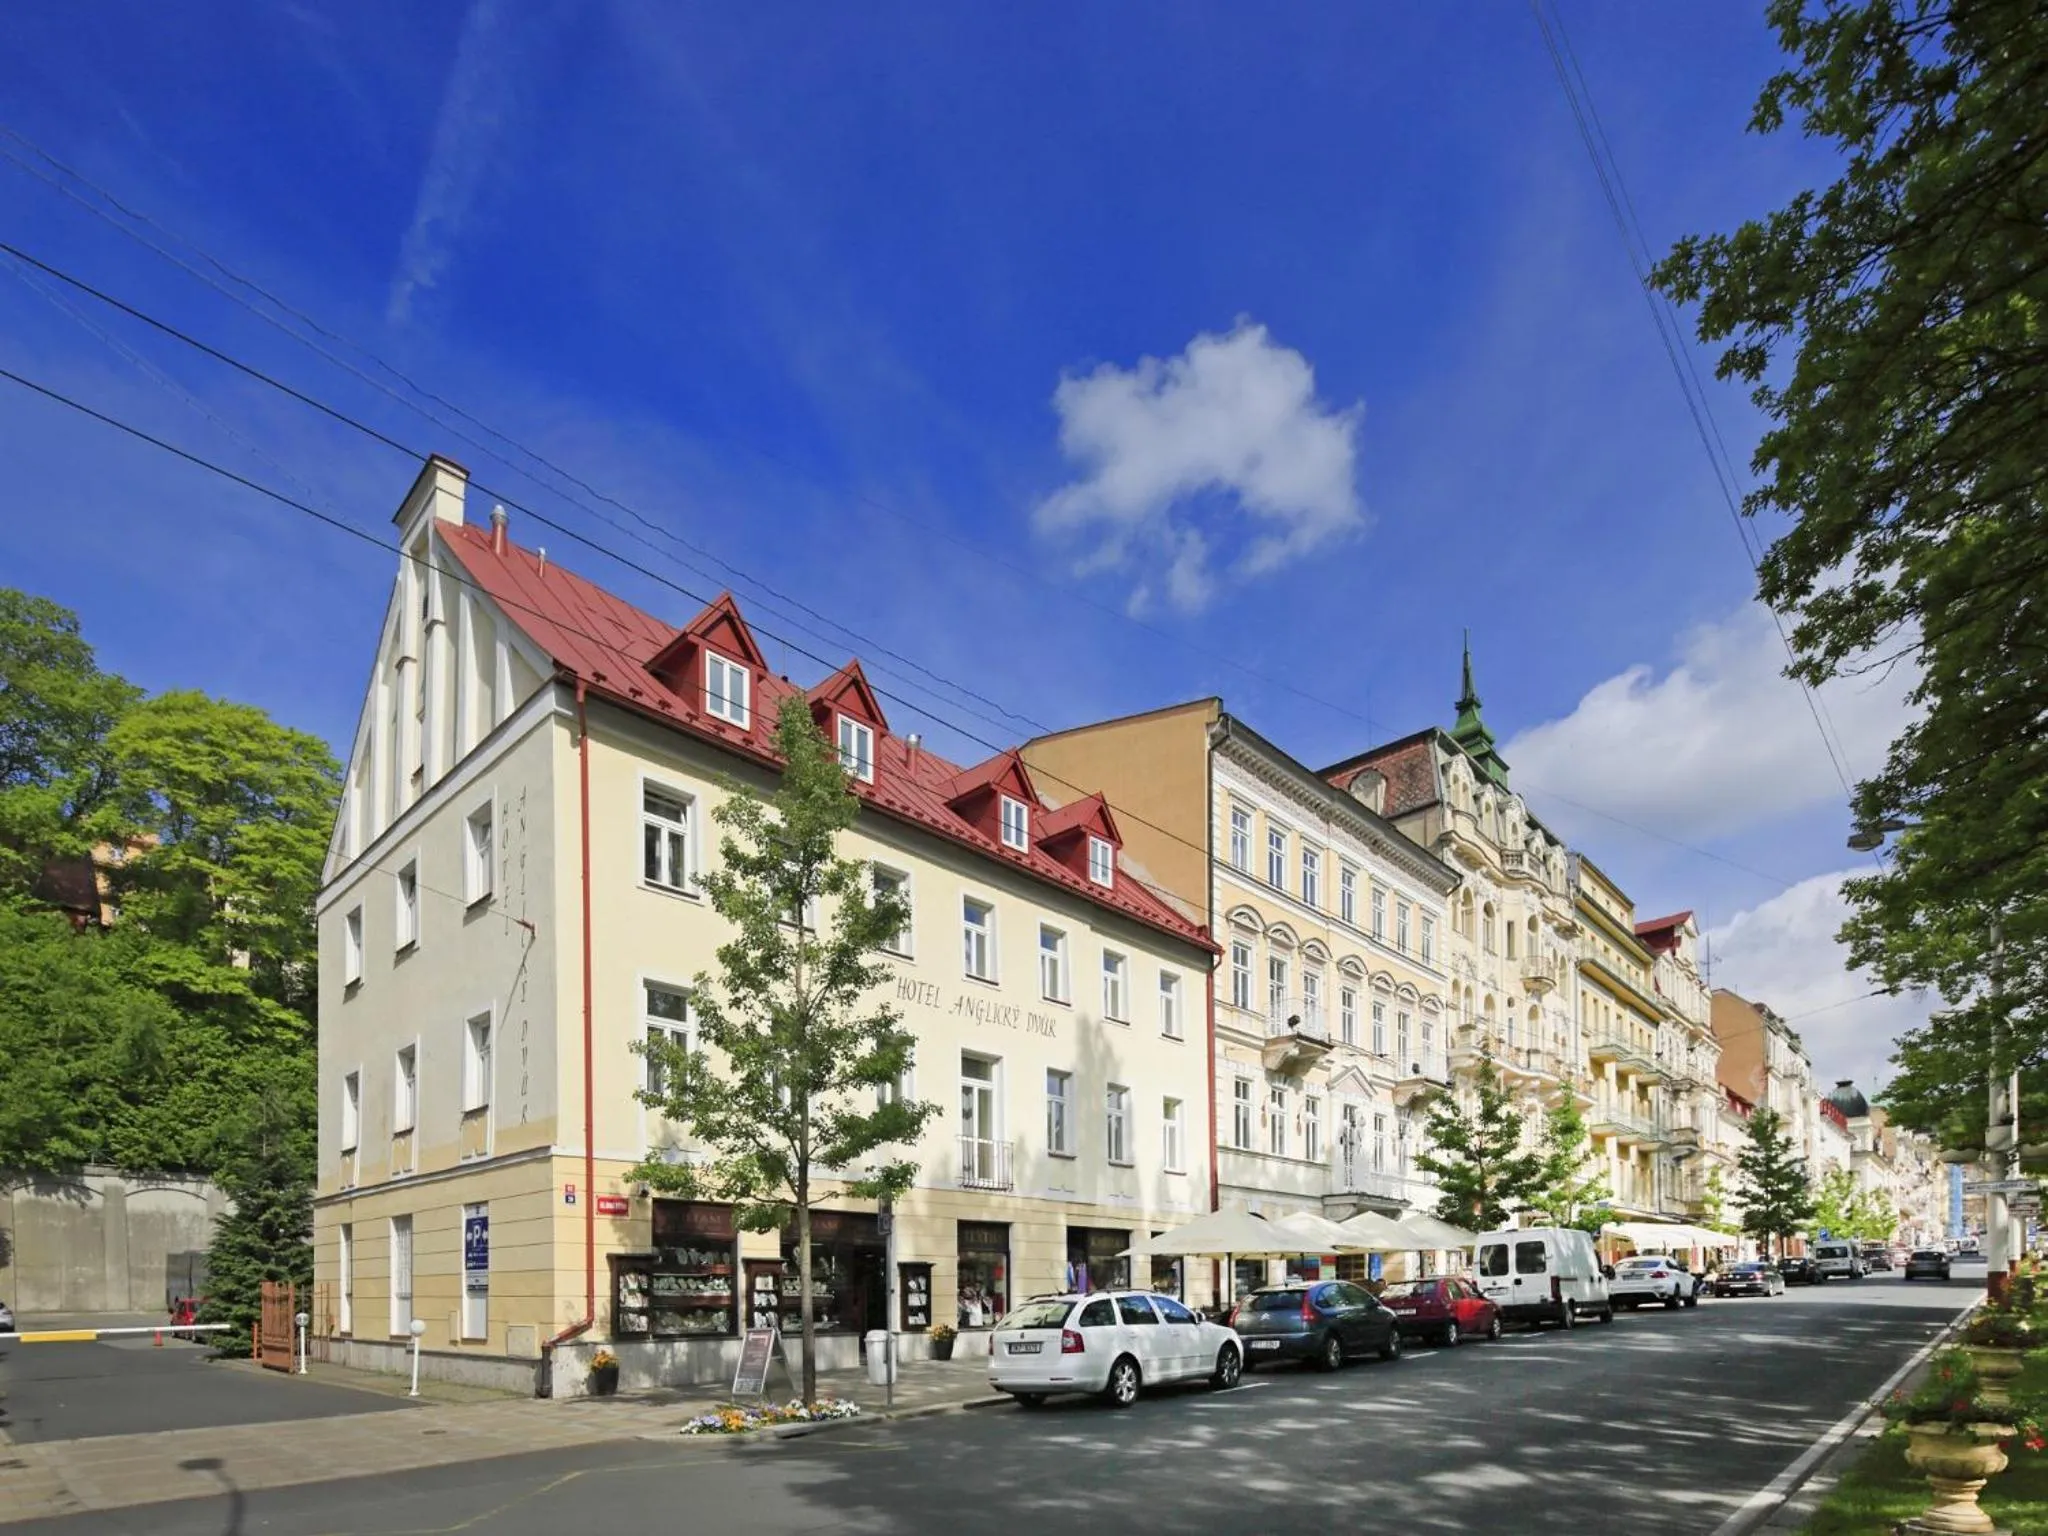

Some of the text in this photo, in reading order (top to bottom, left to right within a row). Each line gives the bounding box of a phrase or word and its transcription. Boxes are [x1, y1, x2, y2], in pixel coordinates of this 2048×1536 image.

[896, 976, 941, 1009] HOTEL
[948, 995, 1021, 1030] ANGLICKÝ
[473, 1225, 481, 1248] P
